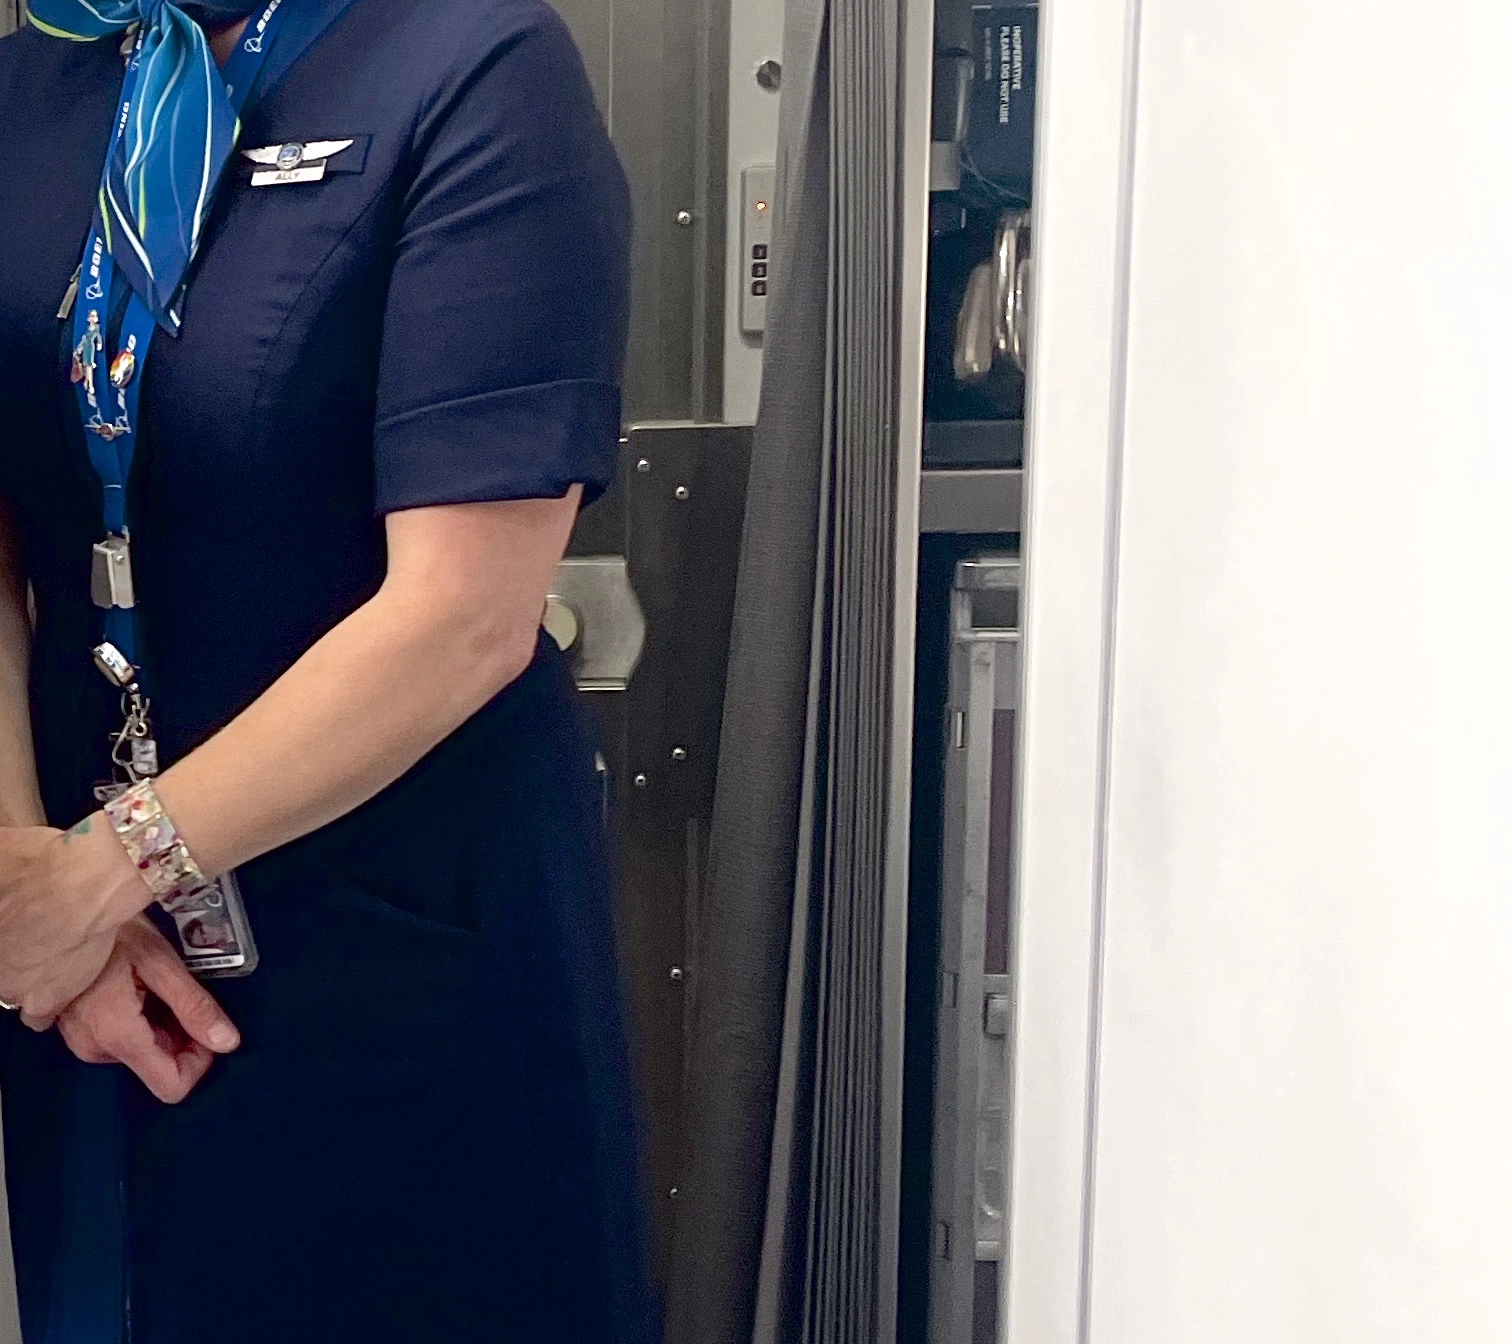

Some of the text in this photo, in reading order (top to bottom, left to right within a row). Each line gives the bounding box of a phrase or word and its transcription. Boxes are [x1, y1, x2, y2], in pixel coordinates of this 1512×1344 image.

[1000, 26, 1011, 63] PLEASE
[1000, 63, 1011, 80] DO
[274, 172, 300, 181] ALLY
